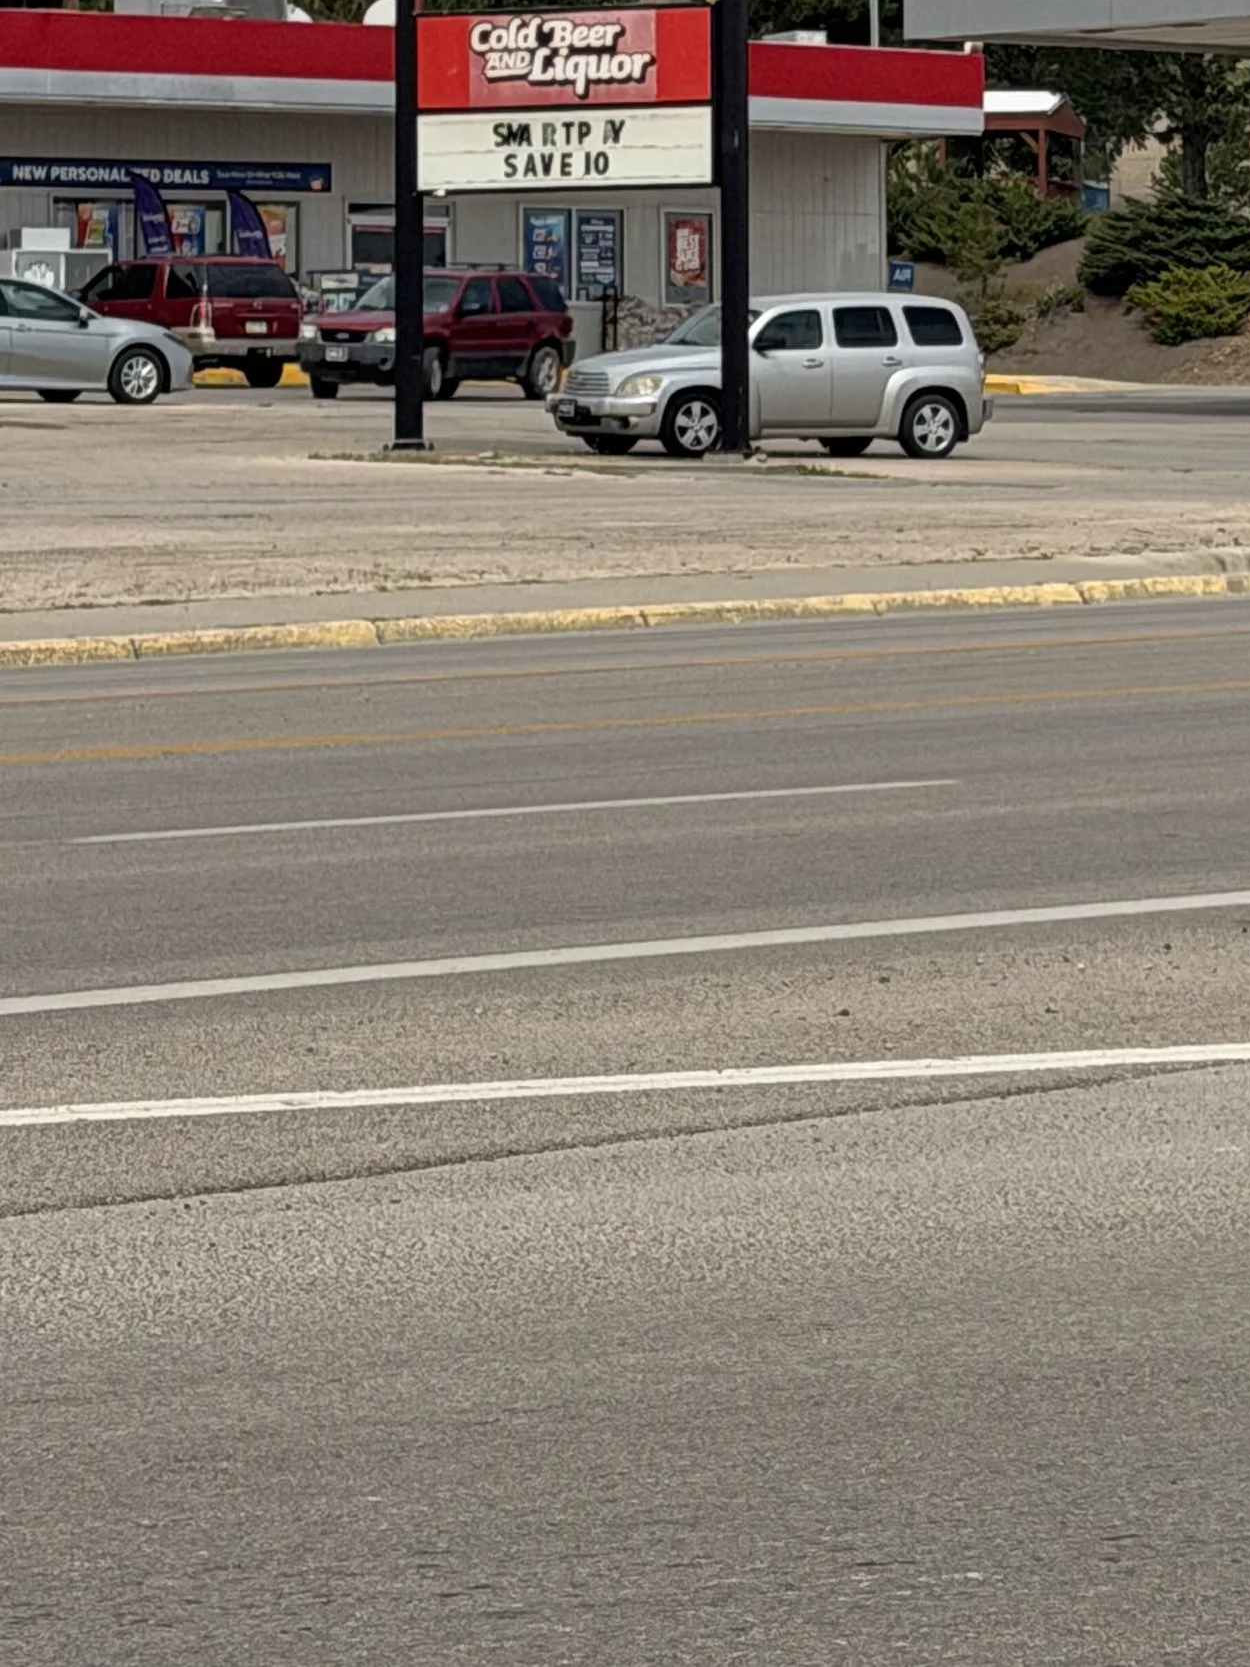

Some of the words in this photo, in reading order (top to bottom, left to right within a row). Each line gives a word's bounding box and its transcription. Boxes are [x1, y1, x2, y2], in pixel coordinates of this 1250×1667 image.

[470, 17, 542, 53] Cold
[542, 20, 622, 49] Beer
[484, 50, 532, 76] AND
[527, 47, 652, 96] Liquor
[12, 164, 48, 182] NEW
[50, 166, 160, 183] PERSONALD
[163, 168, 209, 185] DEALS
[503, 152, 574, 178] SAVE
